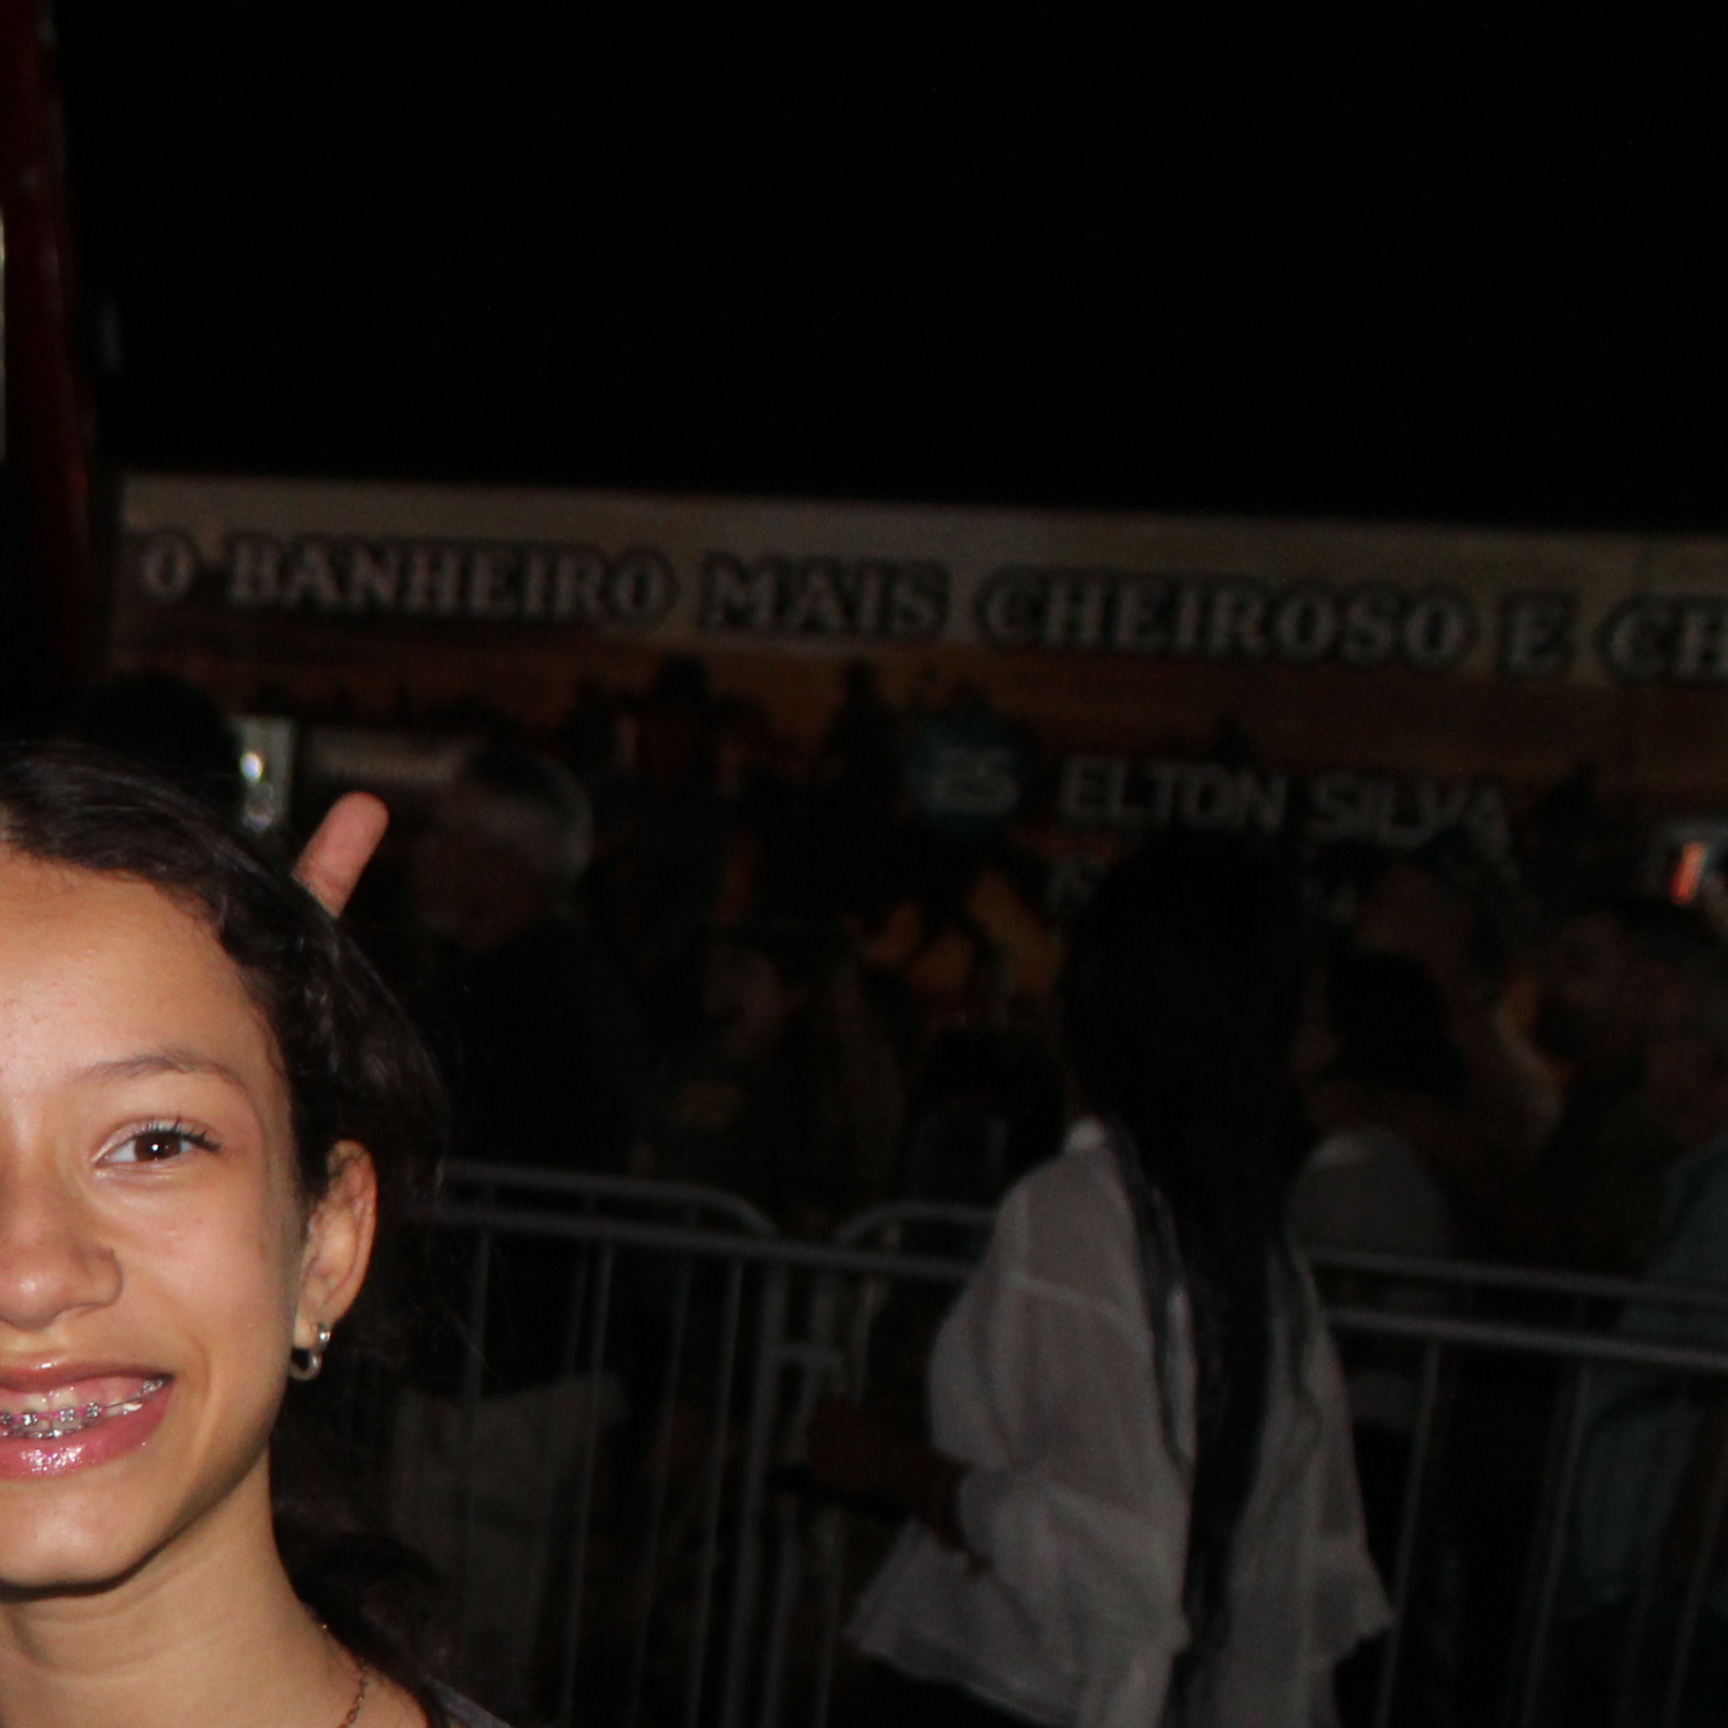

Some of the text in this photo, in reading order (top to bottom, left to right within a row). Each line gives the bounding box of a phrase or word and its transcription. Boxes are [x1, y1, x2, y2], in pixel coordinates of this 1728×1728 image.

[145, 533, 196, 598] O
[228, 539, 668, 620] BANHEIRO
[704, 557, 941, 632] MAIS
[982, 572, 1471, 668] CHEIROSO
[1502, 594, 1572, 678] E
[1058, 752, 1511, 855] ELTON SILVA
